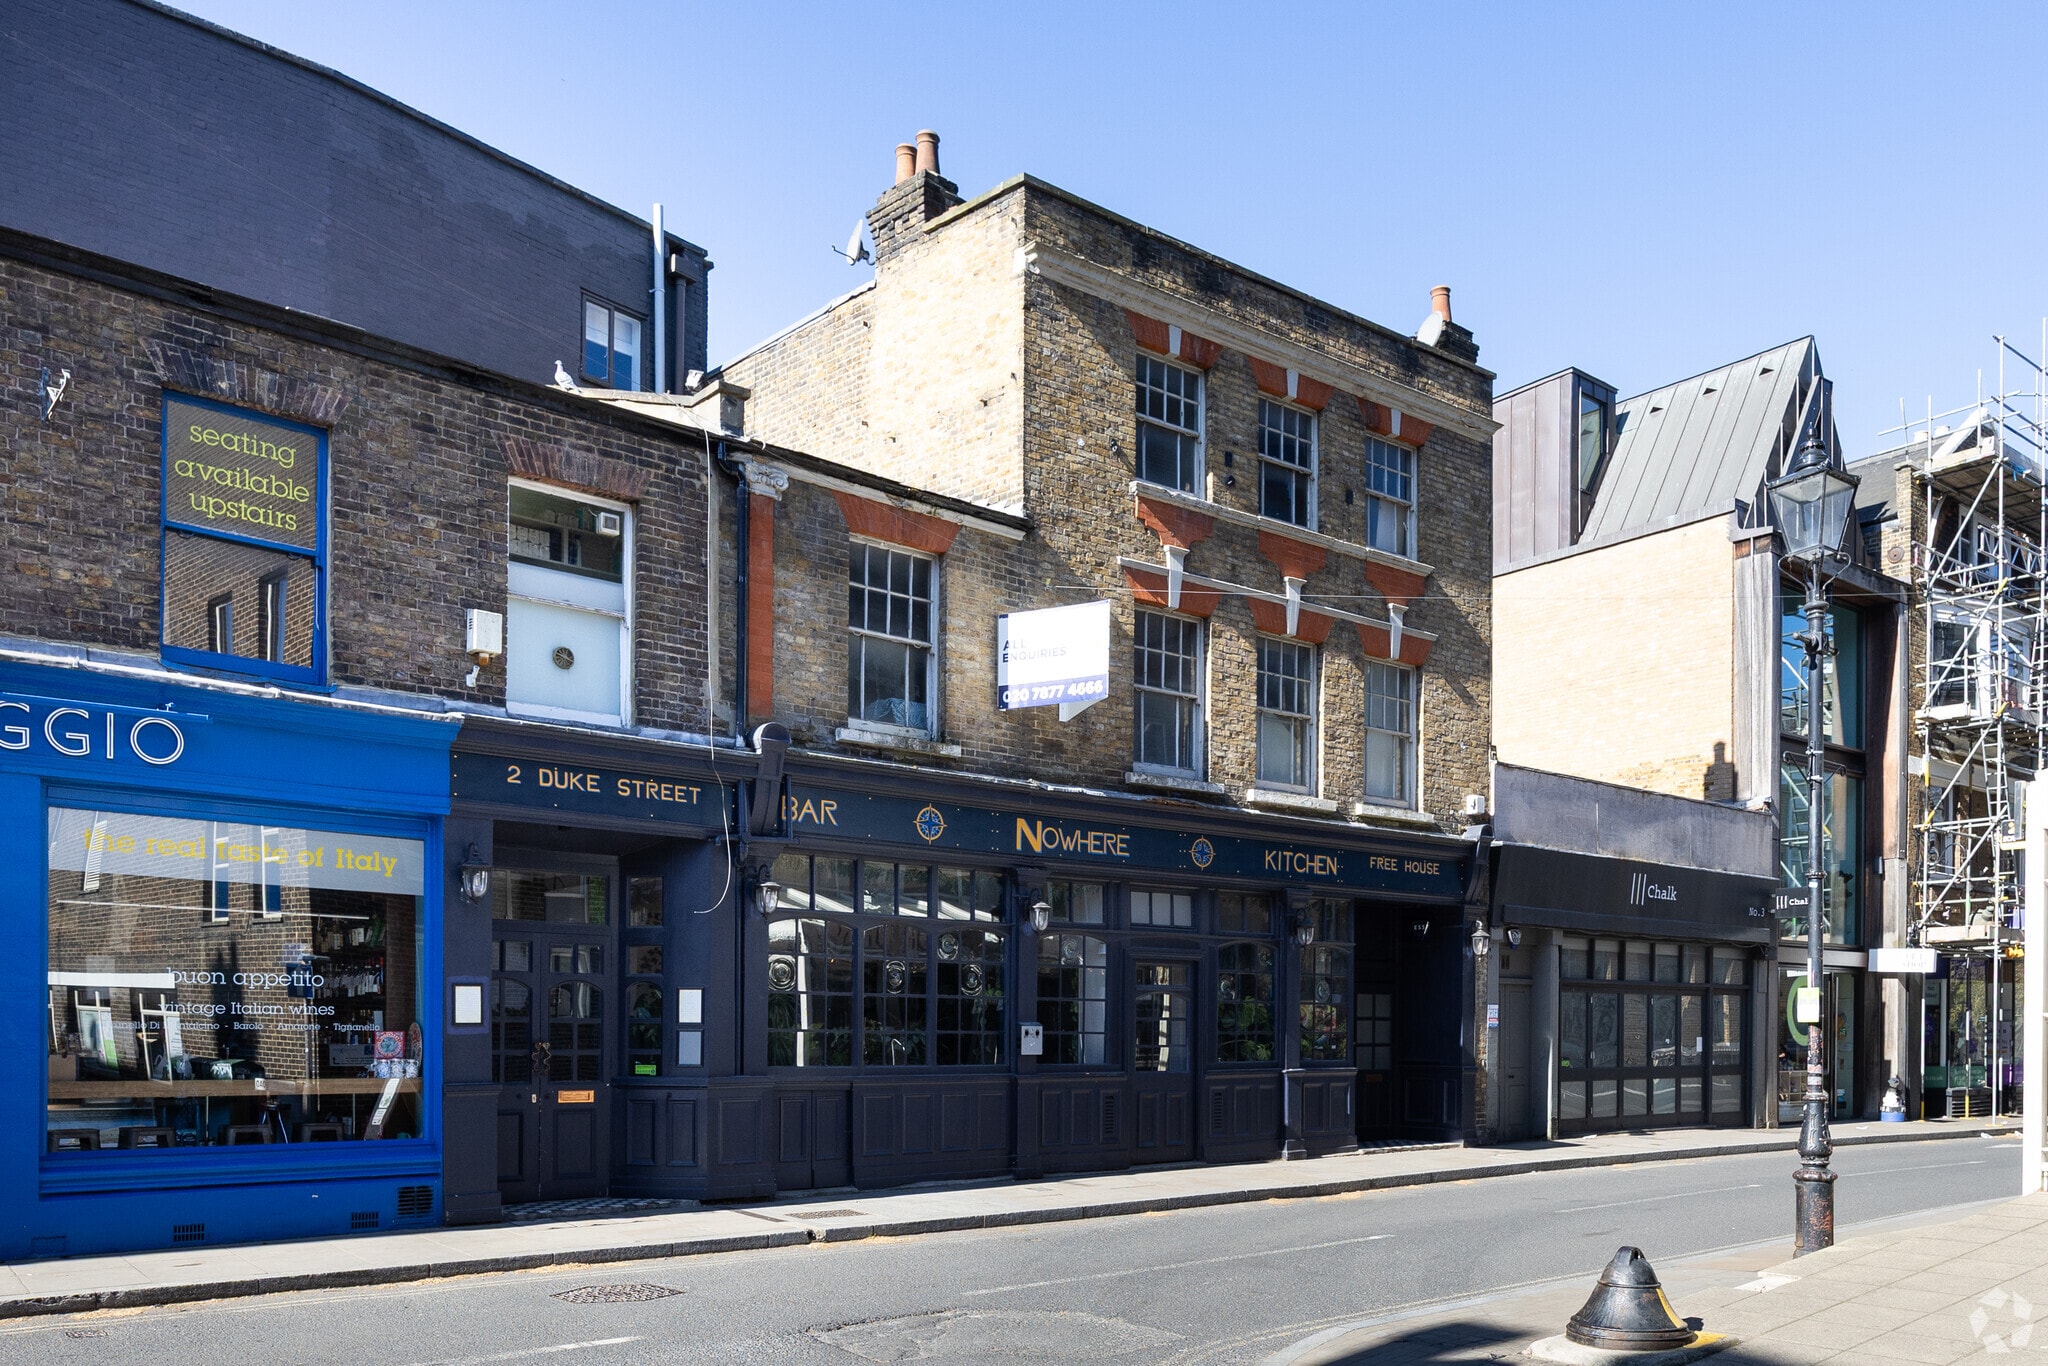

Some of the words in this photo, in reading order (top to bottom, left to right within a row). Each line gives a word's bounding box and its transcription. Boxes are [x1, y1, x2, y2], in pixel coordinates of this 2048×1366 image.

[190, 425, 296, 468] seating
[174, 459, 310, 502] available
[189, 493, 297, 530] upstairs
[1003, 639, 1027, 651] ALL
[1003, 647, 1067, 663] ENQUIRIES
[1003, 688, 1029, 703] 020
[1031, 685, 1065, 700] 7877
[1067, 680, 1103, 696] 4666
[0, 701, 184, 765] GGIO
[507, 765, 521, 784] 2
[538, 768, 601, 793] DUKE
[617, 778, 702, 805] STREET
[781, 795, 839, 827] BAR
[1016, 817, 1131, 857] NOWHERE
[82, 827, 136, 854] the
[145, 836, 207, 859] real
[216, 841, 288, 864] taste
[297, 847, 324, 867] of
[335, 848, 397, 877] Italy
[1265, 849, 1337, 876] KITCHEN
[1369, 856, 1398, 871] FREE
[1404, 860, 1440, 875] HOUSE
[1647, 884, 1677, 901] Chalk
[1789, 897, 1809, 906] Chal
[166, 967, 226, 985] buon
[232, 970, 325, 989] appetito
[158, 1001, 226, 1017] vintage
[230, 1002, 284, 1016] Italian
[288, 1002, 335, 1016] wines
[150, 1021, 160, 1030] Di
[233, 1022, 264, 1030] Barolo
[333, 1023, 381, 1032] Tignanello
